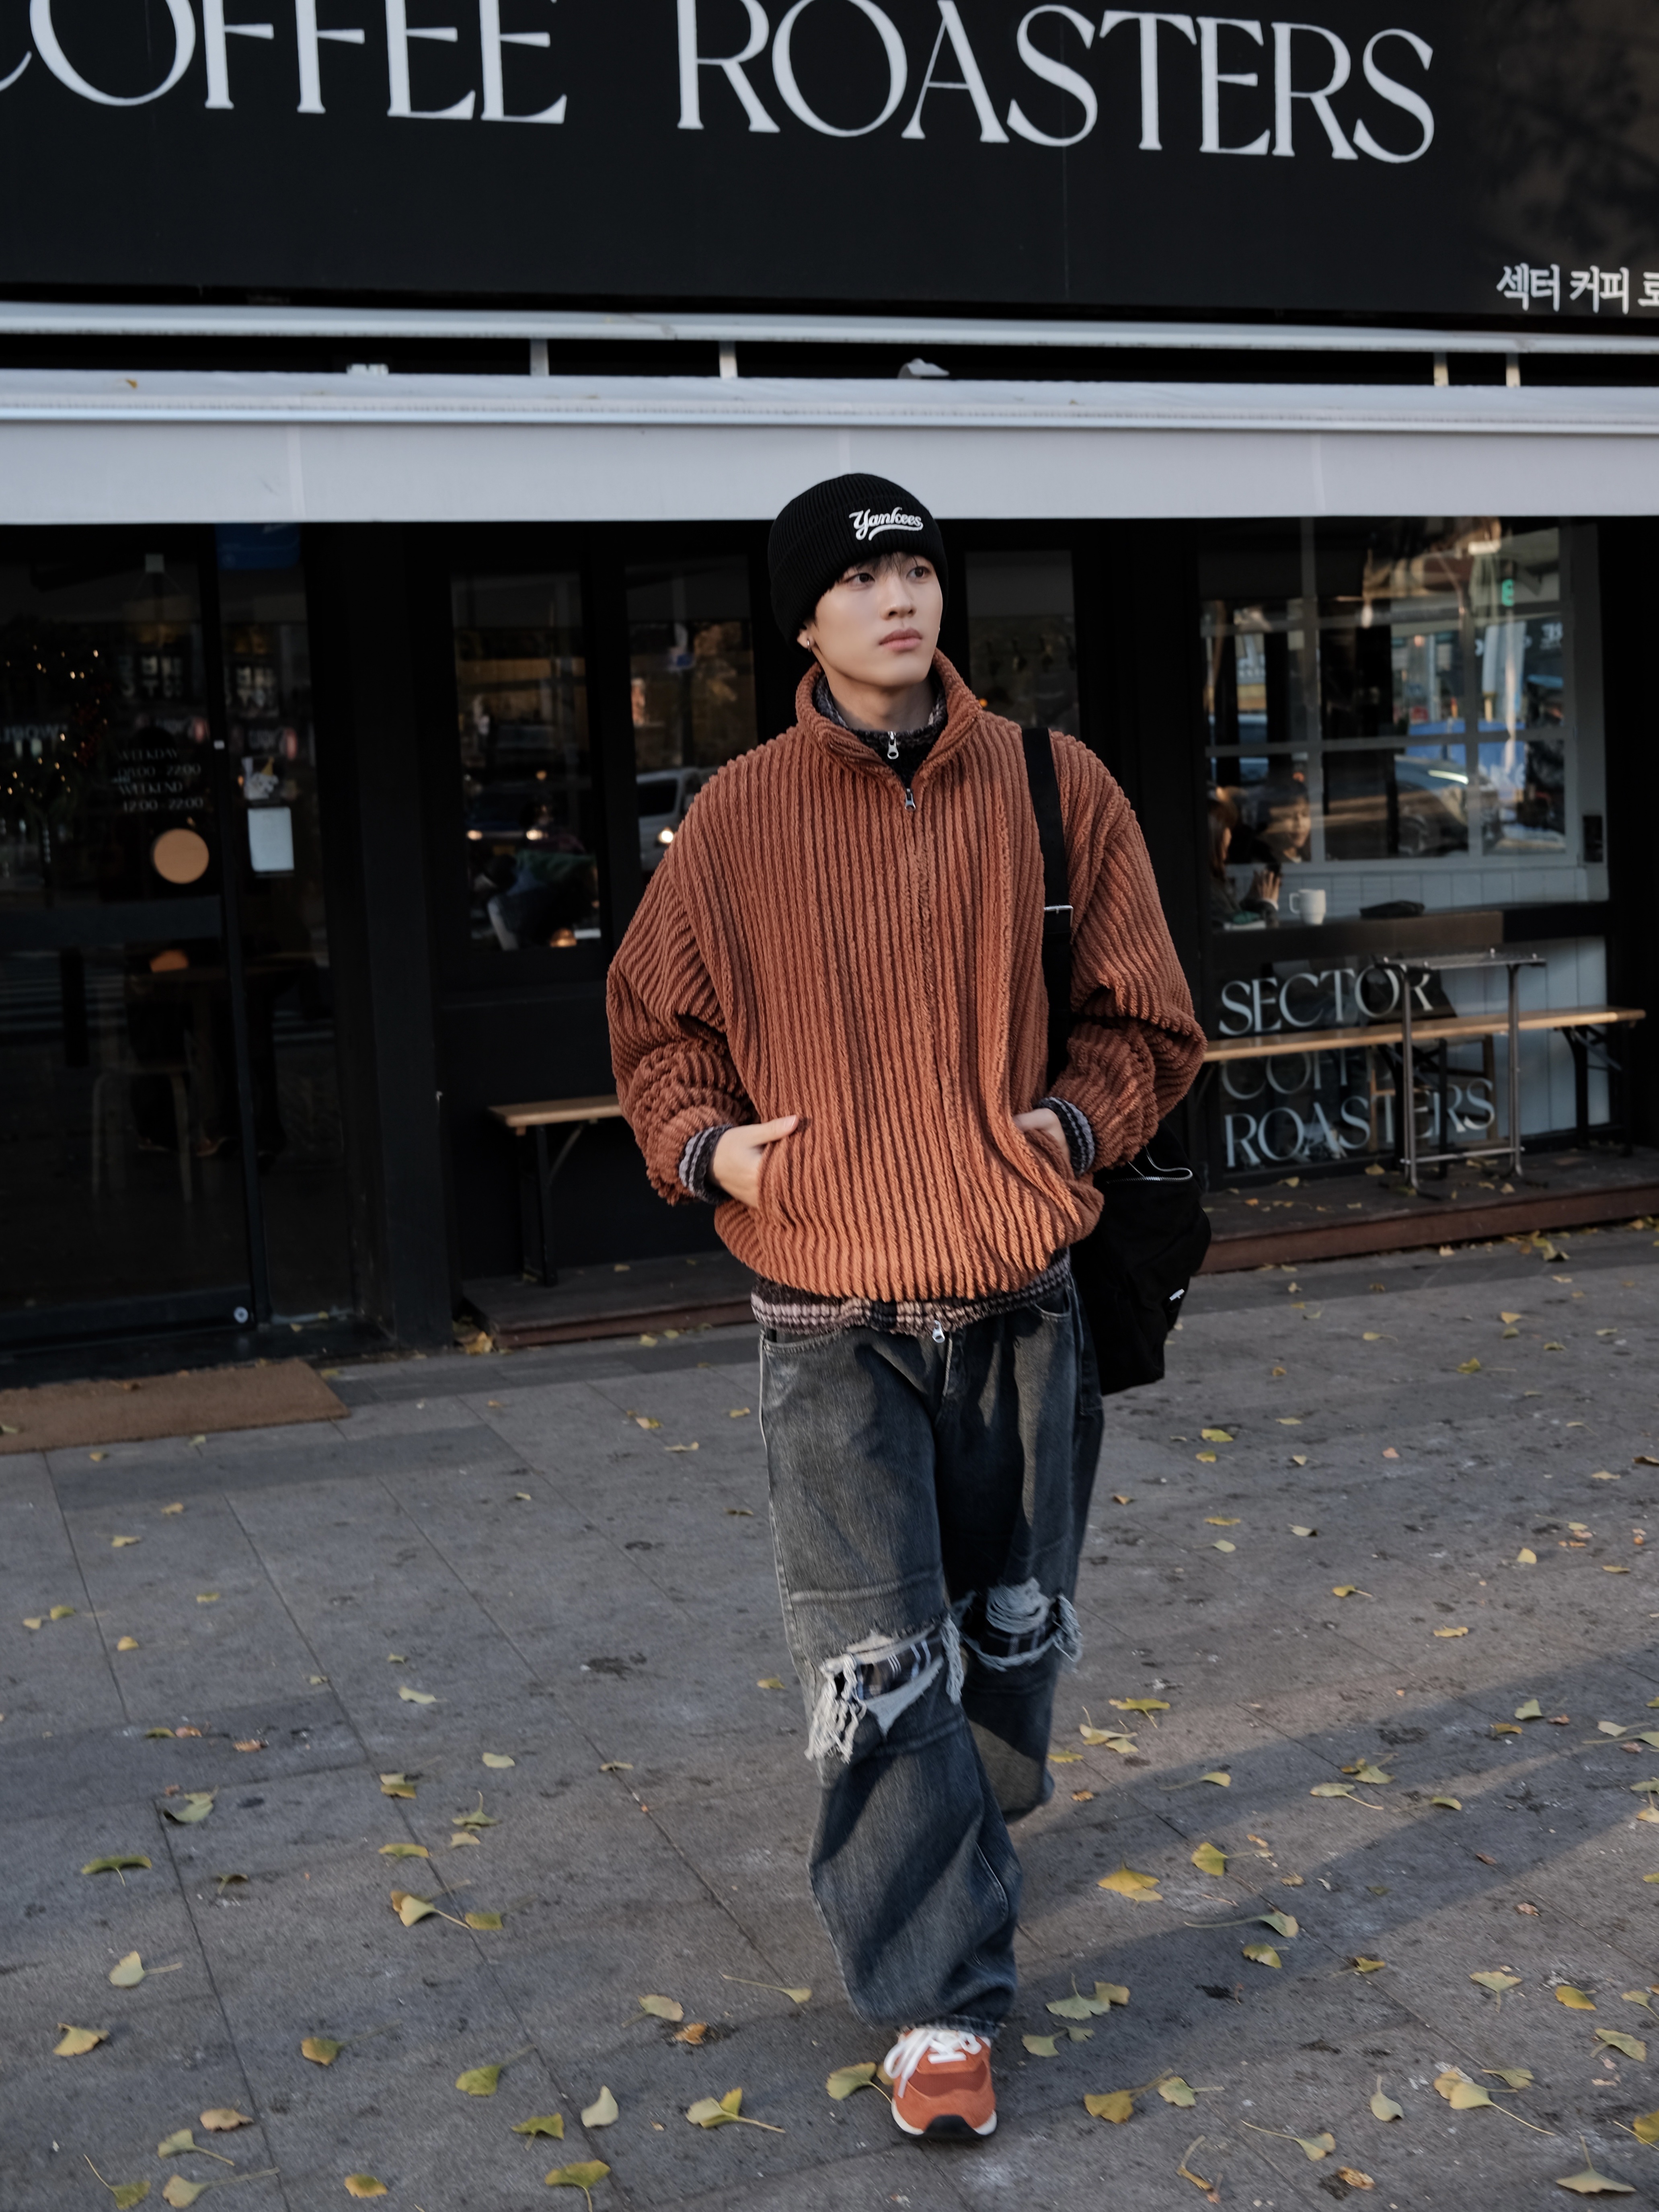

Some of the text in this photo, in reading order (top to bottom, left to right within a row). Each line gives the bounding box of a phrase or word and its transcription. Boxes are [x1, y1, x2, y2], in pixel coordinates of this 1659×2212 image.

[0, 0, 1435, 162] OFFEE ROASTERS
[1496, 263, 1560, 312] 섹터
[1569, 265, 1630, 315] 커피
[849, 507, 924, 540] Yankees
